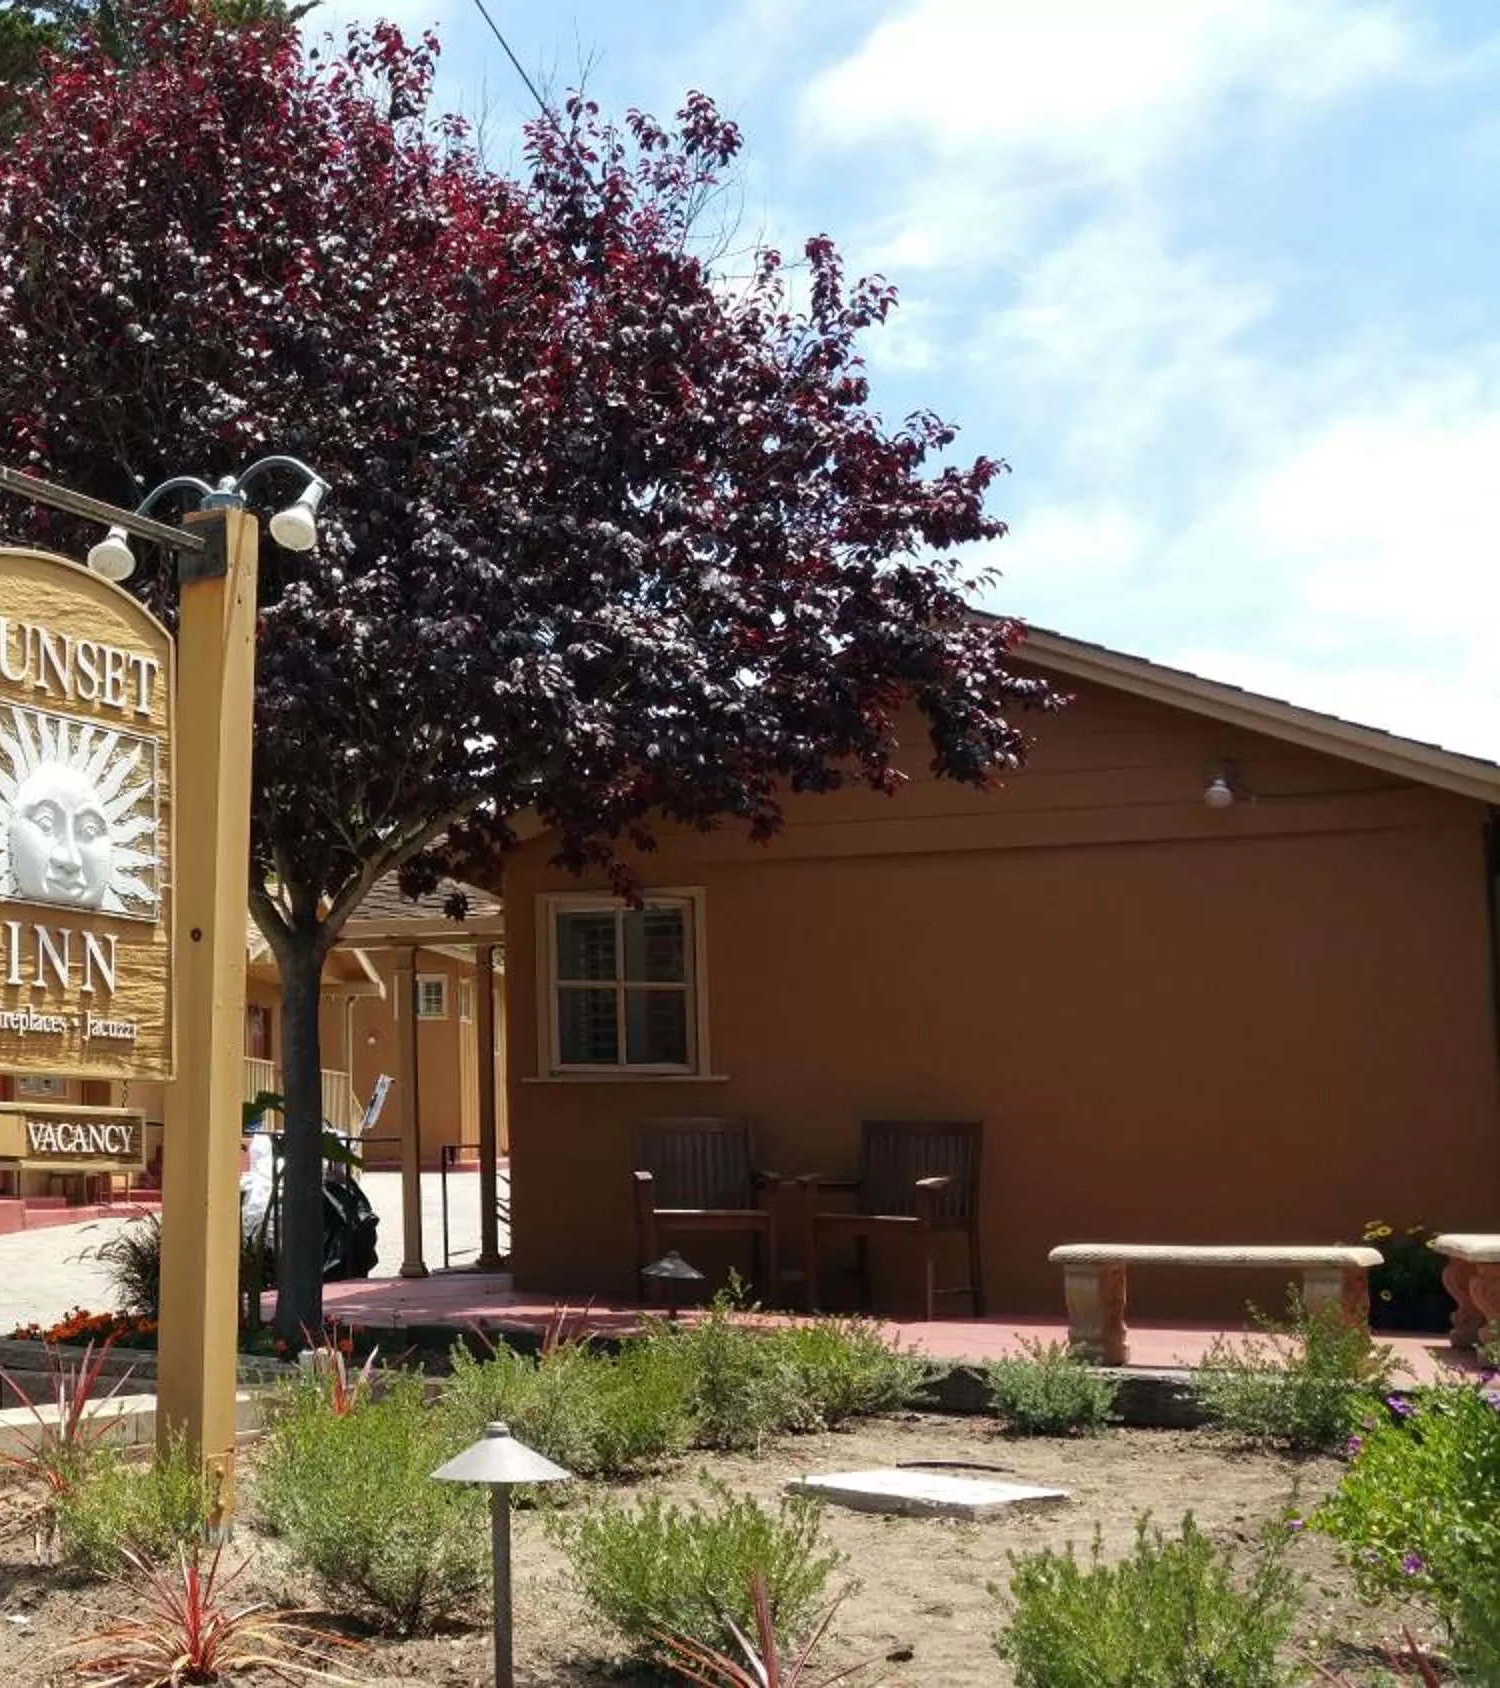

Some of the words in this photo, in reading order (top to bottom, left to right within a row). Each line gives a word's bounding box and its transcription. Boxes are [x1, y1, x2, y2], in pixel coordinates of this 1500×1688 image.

[5, 920, 119, 994] INN
[83, 1009, 137, 1041] Jacuzzi
[27, 1122, 133, 1153] VACANCY
